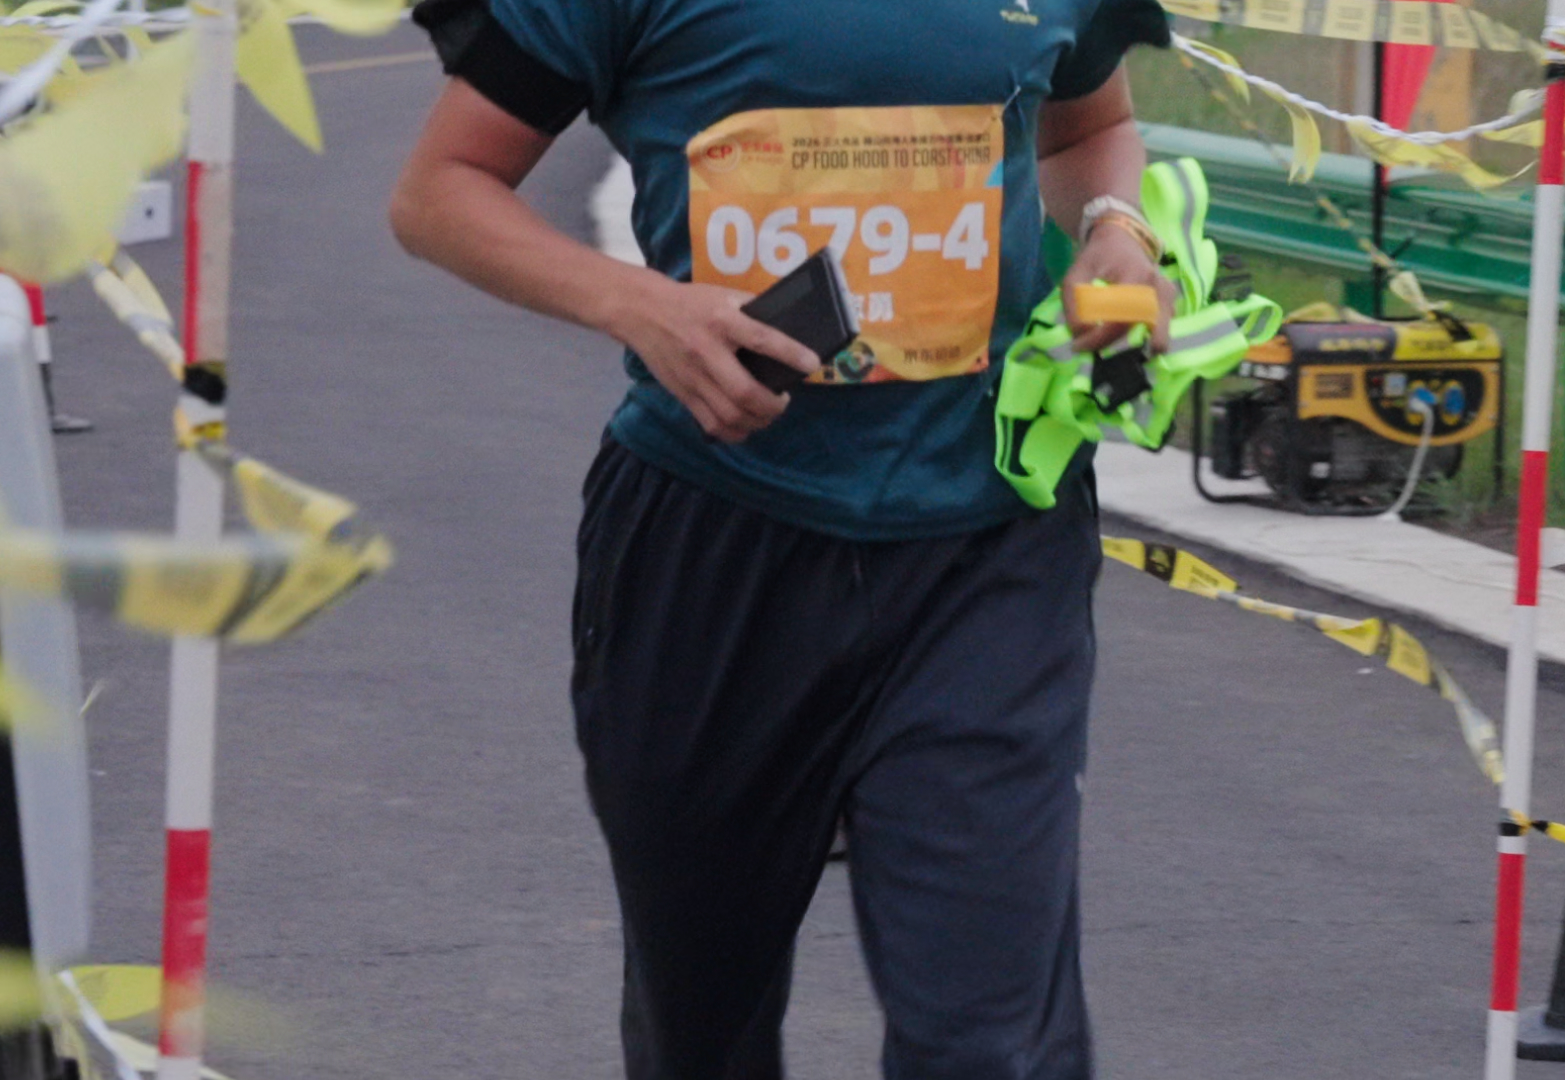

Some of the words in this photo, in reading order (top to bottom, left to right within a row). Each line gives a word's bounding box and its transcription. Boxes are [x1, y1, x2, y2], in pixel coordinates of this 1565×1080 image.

[706, 144, 733, 160] CP
[792, 150, 809, 170] CP
[813, 150, 848, 169] FOOD
[853, 149, 889, 168] HOOD
[894, 148, 909, 167] TO
[913, 147, 951, 167] COAST
[954, 145, 991, 165] CHINA
[706, 202, 989, 276] 0679-4
